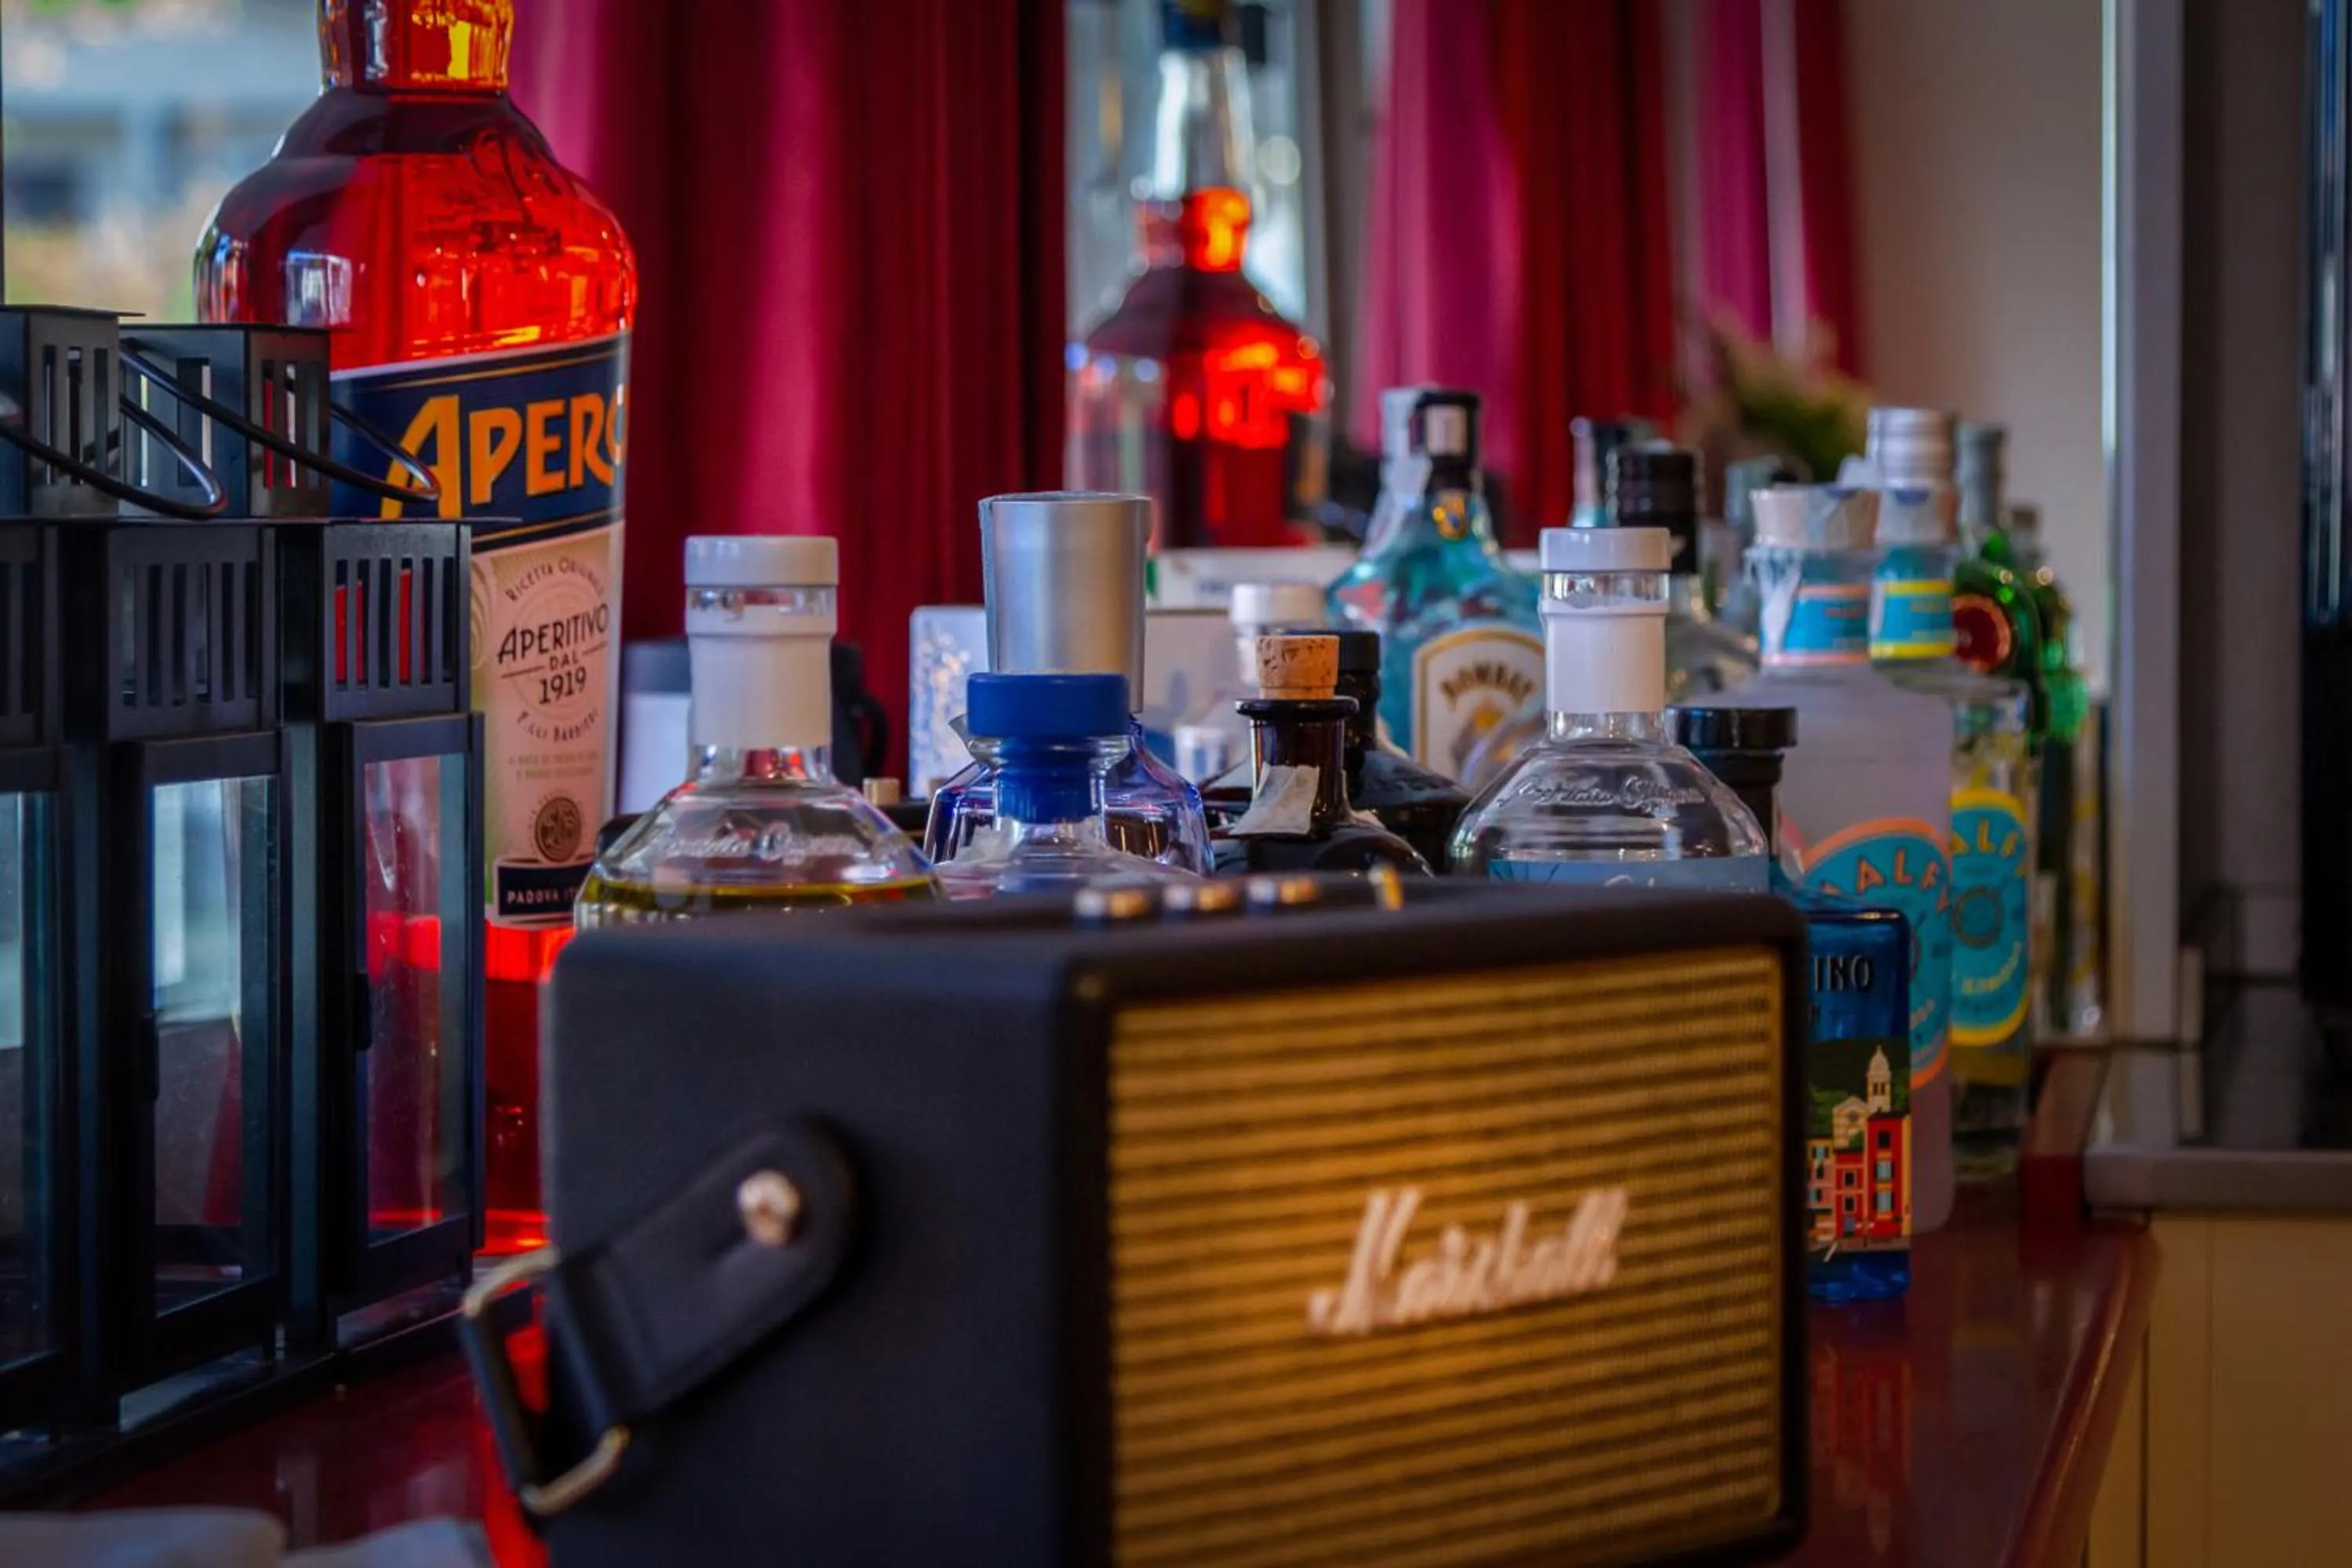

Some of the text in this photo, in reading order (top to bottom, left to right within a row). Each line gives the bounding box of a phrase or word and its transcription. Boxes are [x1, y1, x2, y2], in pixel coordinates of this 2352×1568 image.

[497, 603, 609, 665] APERITIVO
[549, 650, 579, 670] DAL
[539, 666, 586, 705] 1919
[507, 887, 559, 905] PADOVA
